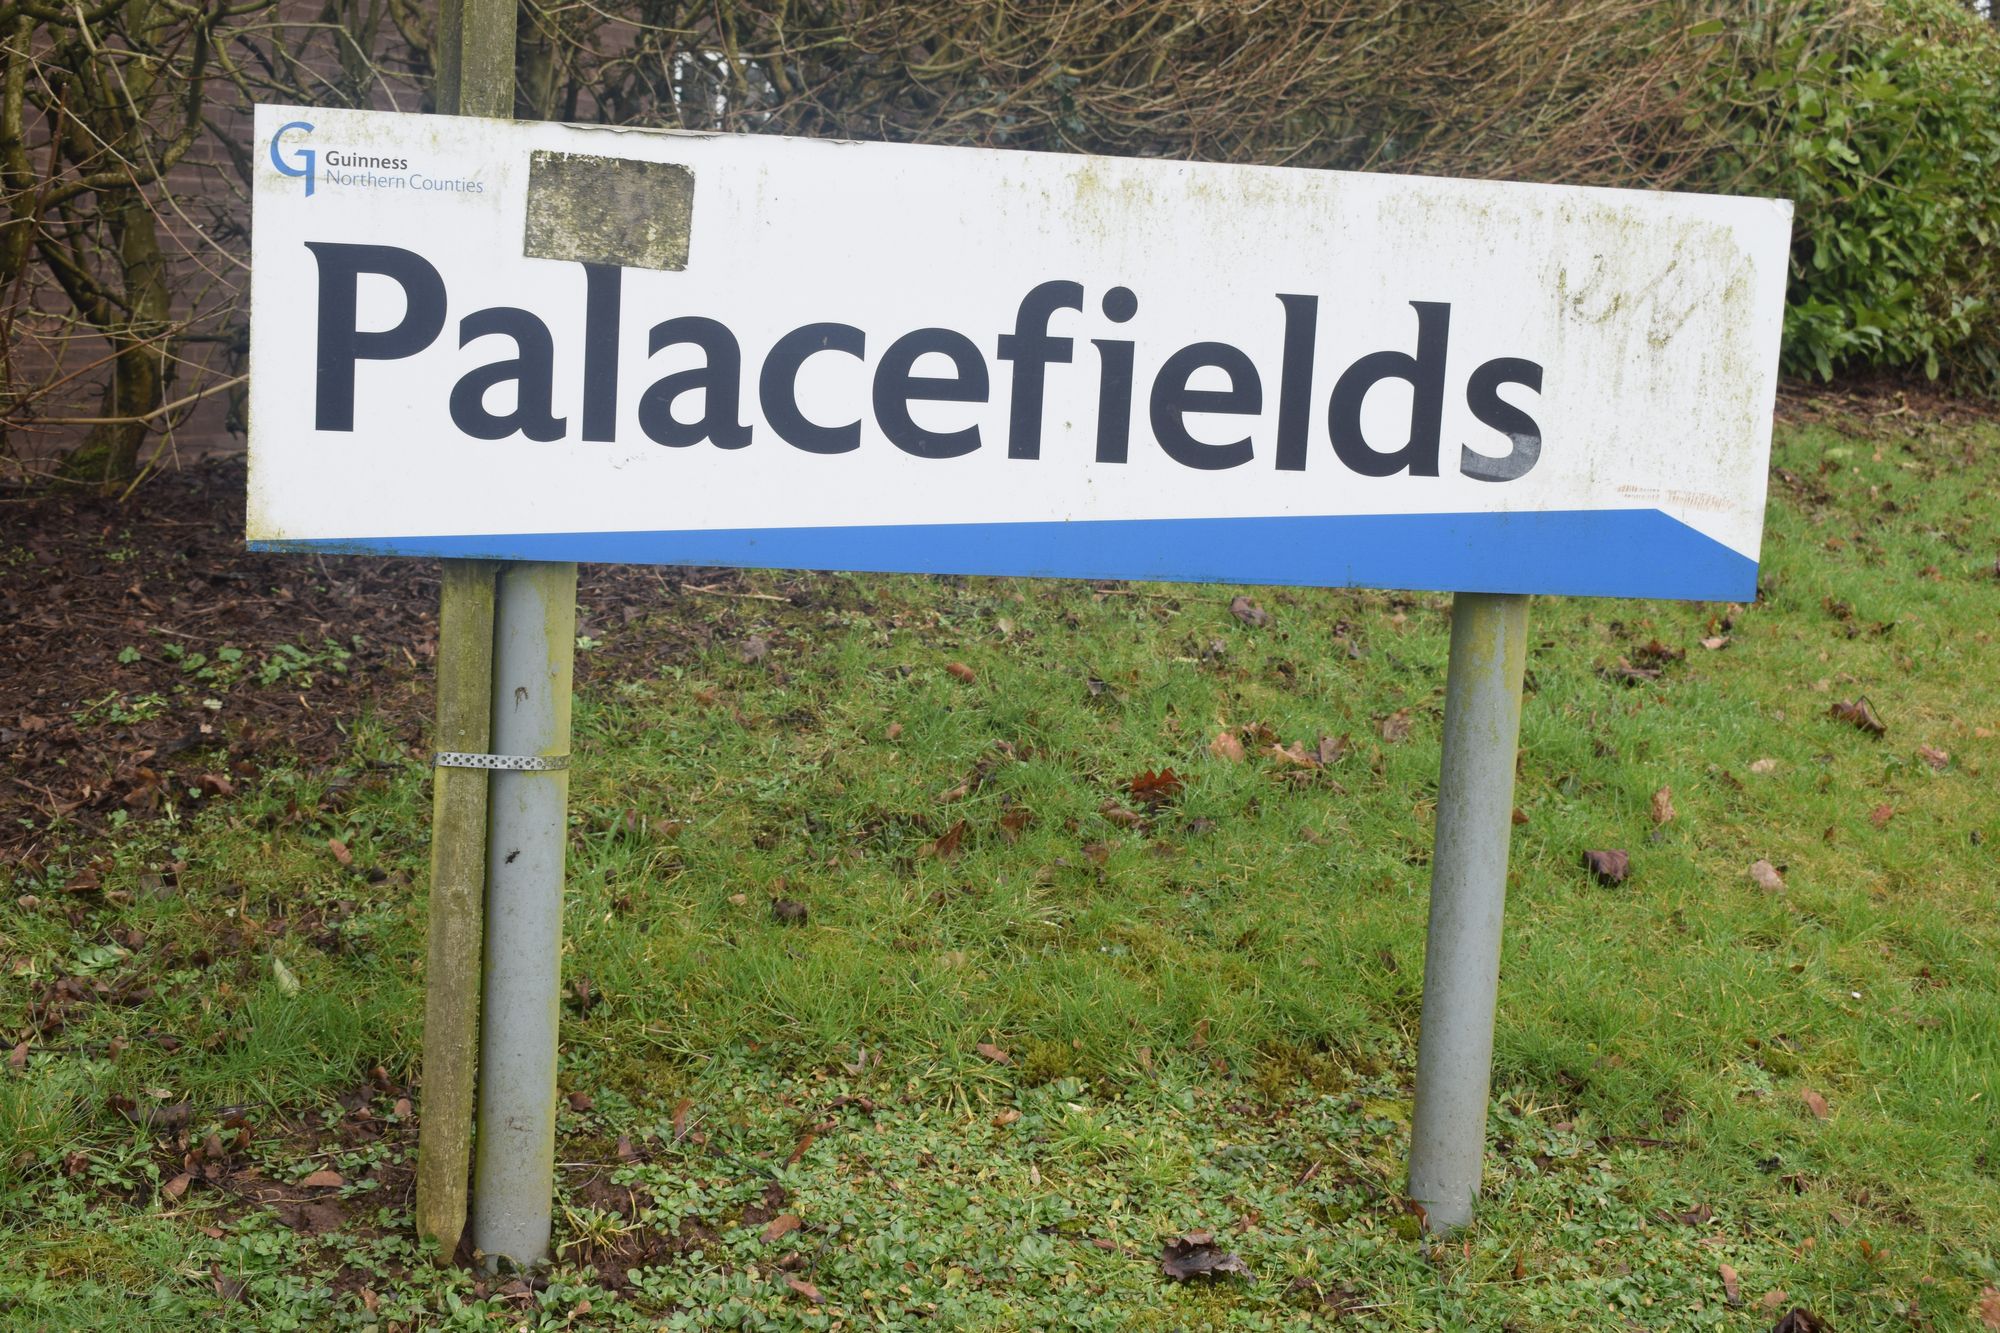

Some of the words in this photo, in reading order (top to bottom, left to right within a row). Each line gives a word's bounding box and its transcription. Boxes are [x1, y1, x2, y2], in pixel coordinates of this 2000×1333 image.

[325, 150, 408, 170] Guinness
[325, 168, 406, 189] Northern
[410, 173, 484, 194] Counties
[304, 241, 1544, 483] Palacefields
